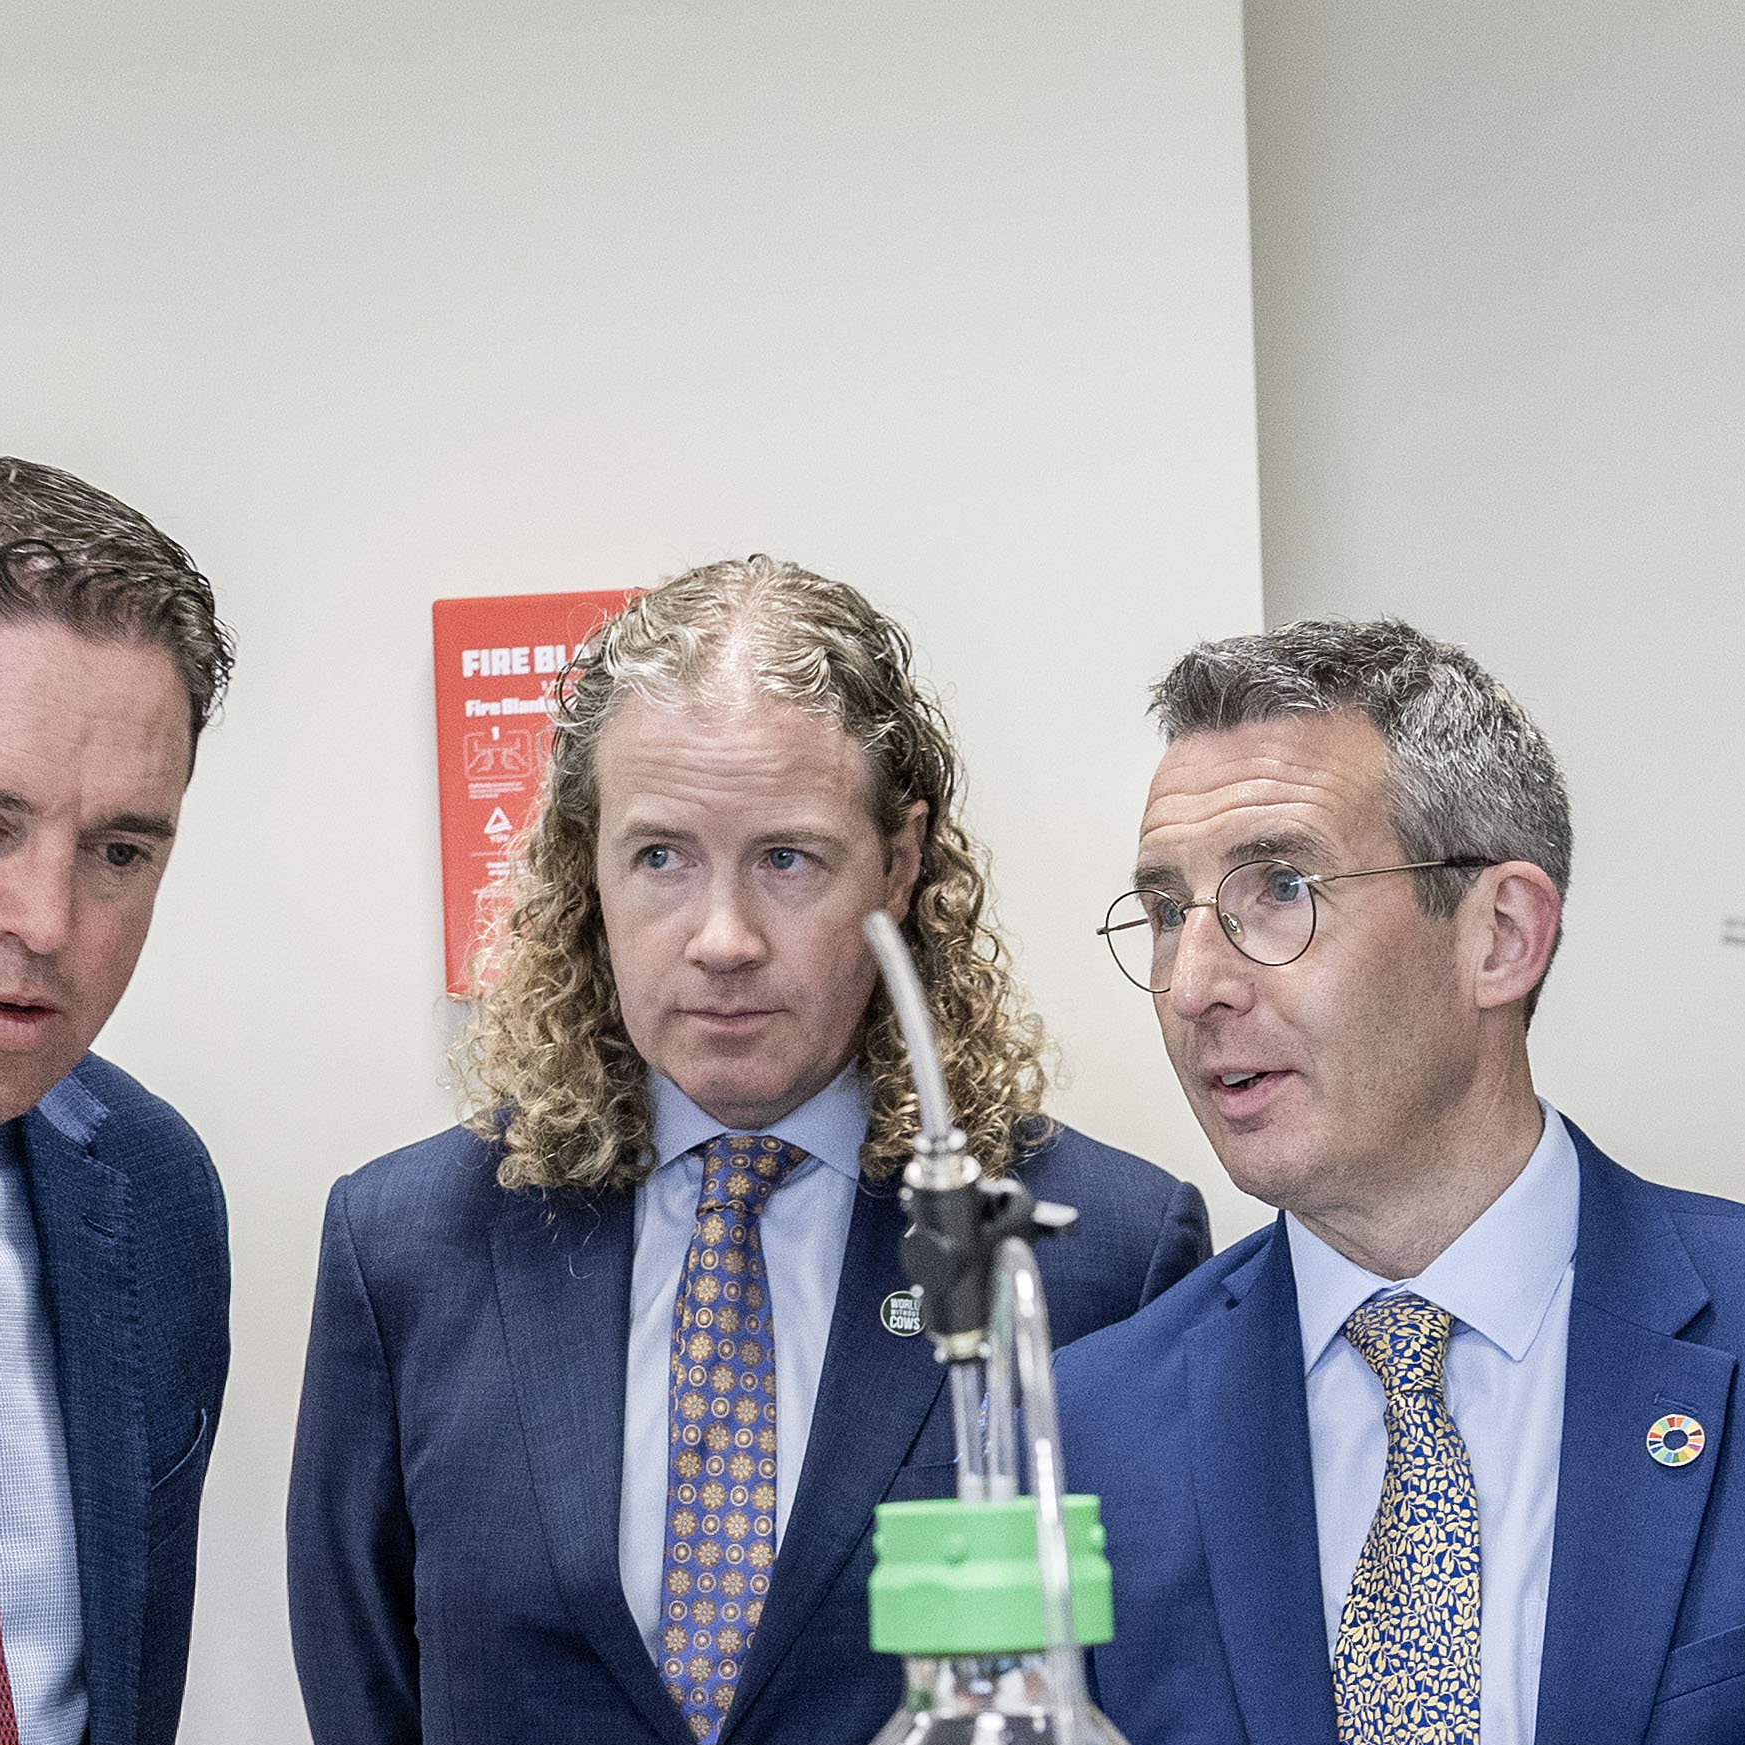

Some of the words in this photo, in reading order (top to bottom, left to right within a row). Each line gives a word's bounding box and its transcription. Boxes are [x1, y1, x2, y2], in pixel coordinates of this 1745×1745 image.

[461, 647, 531, 678] FIRE
[533, 643, 592, 675] BLA
[889, 1315, 921, 1330] COWS
